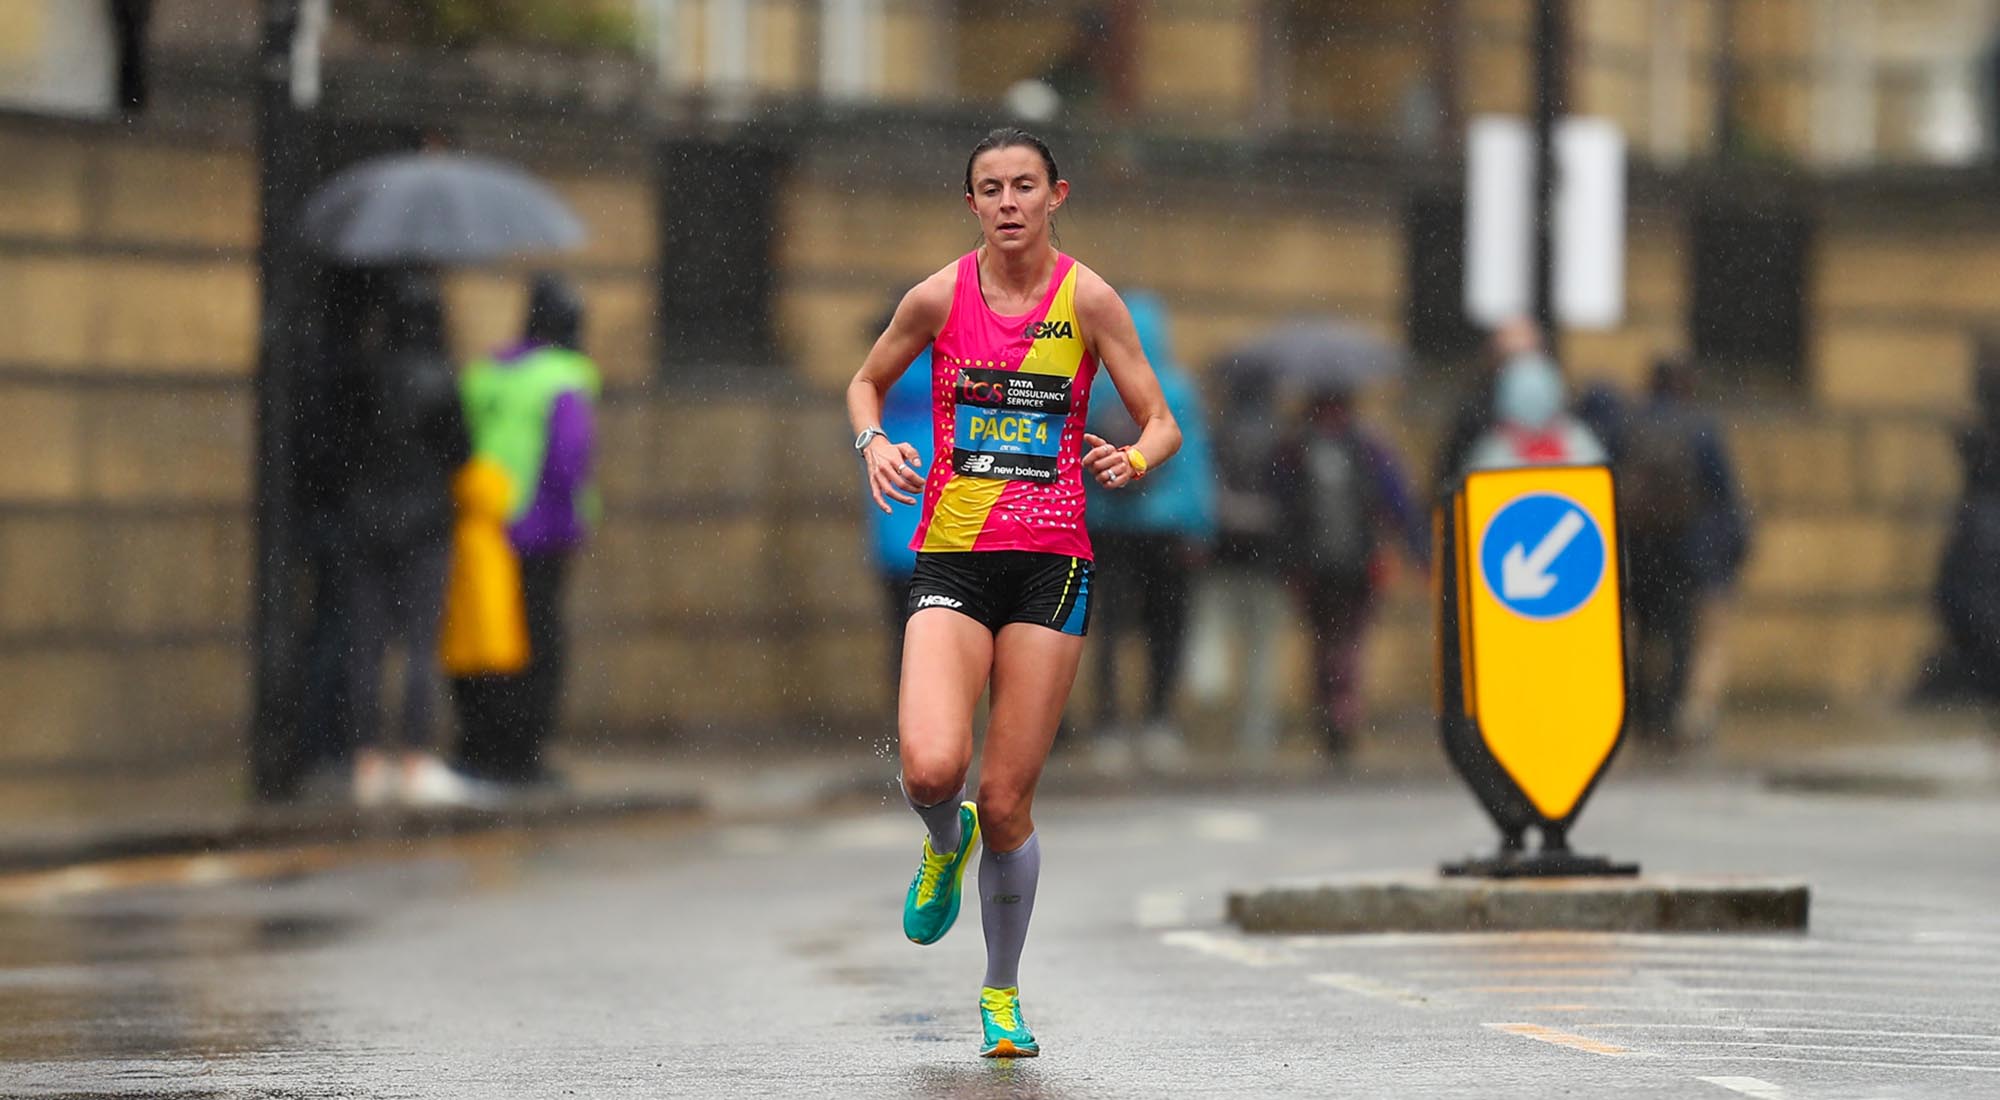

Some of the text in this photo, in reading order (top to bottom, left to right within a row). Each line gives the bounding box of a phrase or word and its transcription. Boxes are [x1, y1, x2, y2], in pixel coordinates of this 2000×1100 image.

[1008, 378, 1034, 389] TATA
[1007, 388, 1065, 401] CONSULTANCY
[1006, 398, 1044, 408] SERVICES
[969, 416, 1047, 445] PACE 4
[993, 465, 1050, 478] new balance
